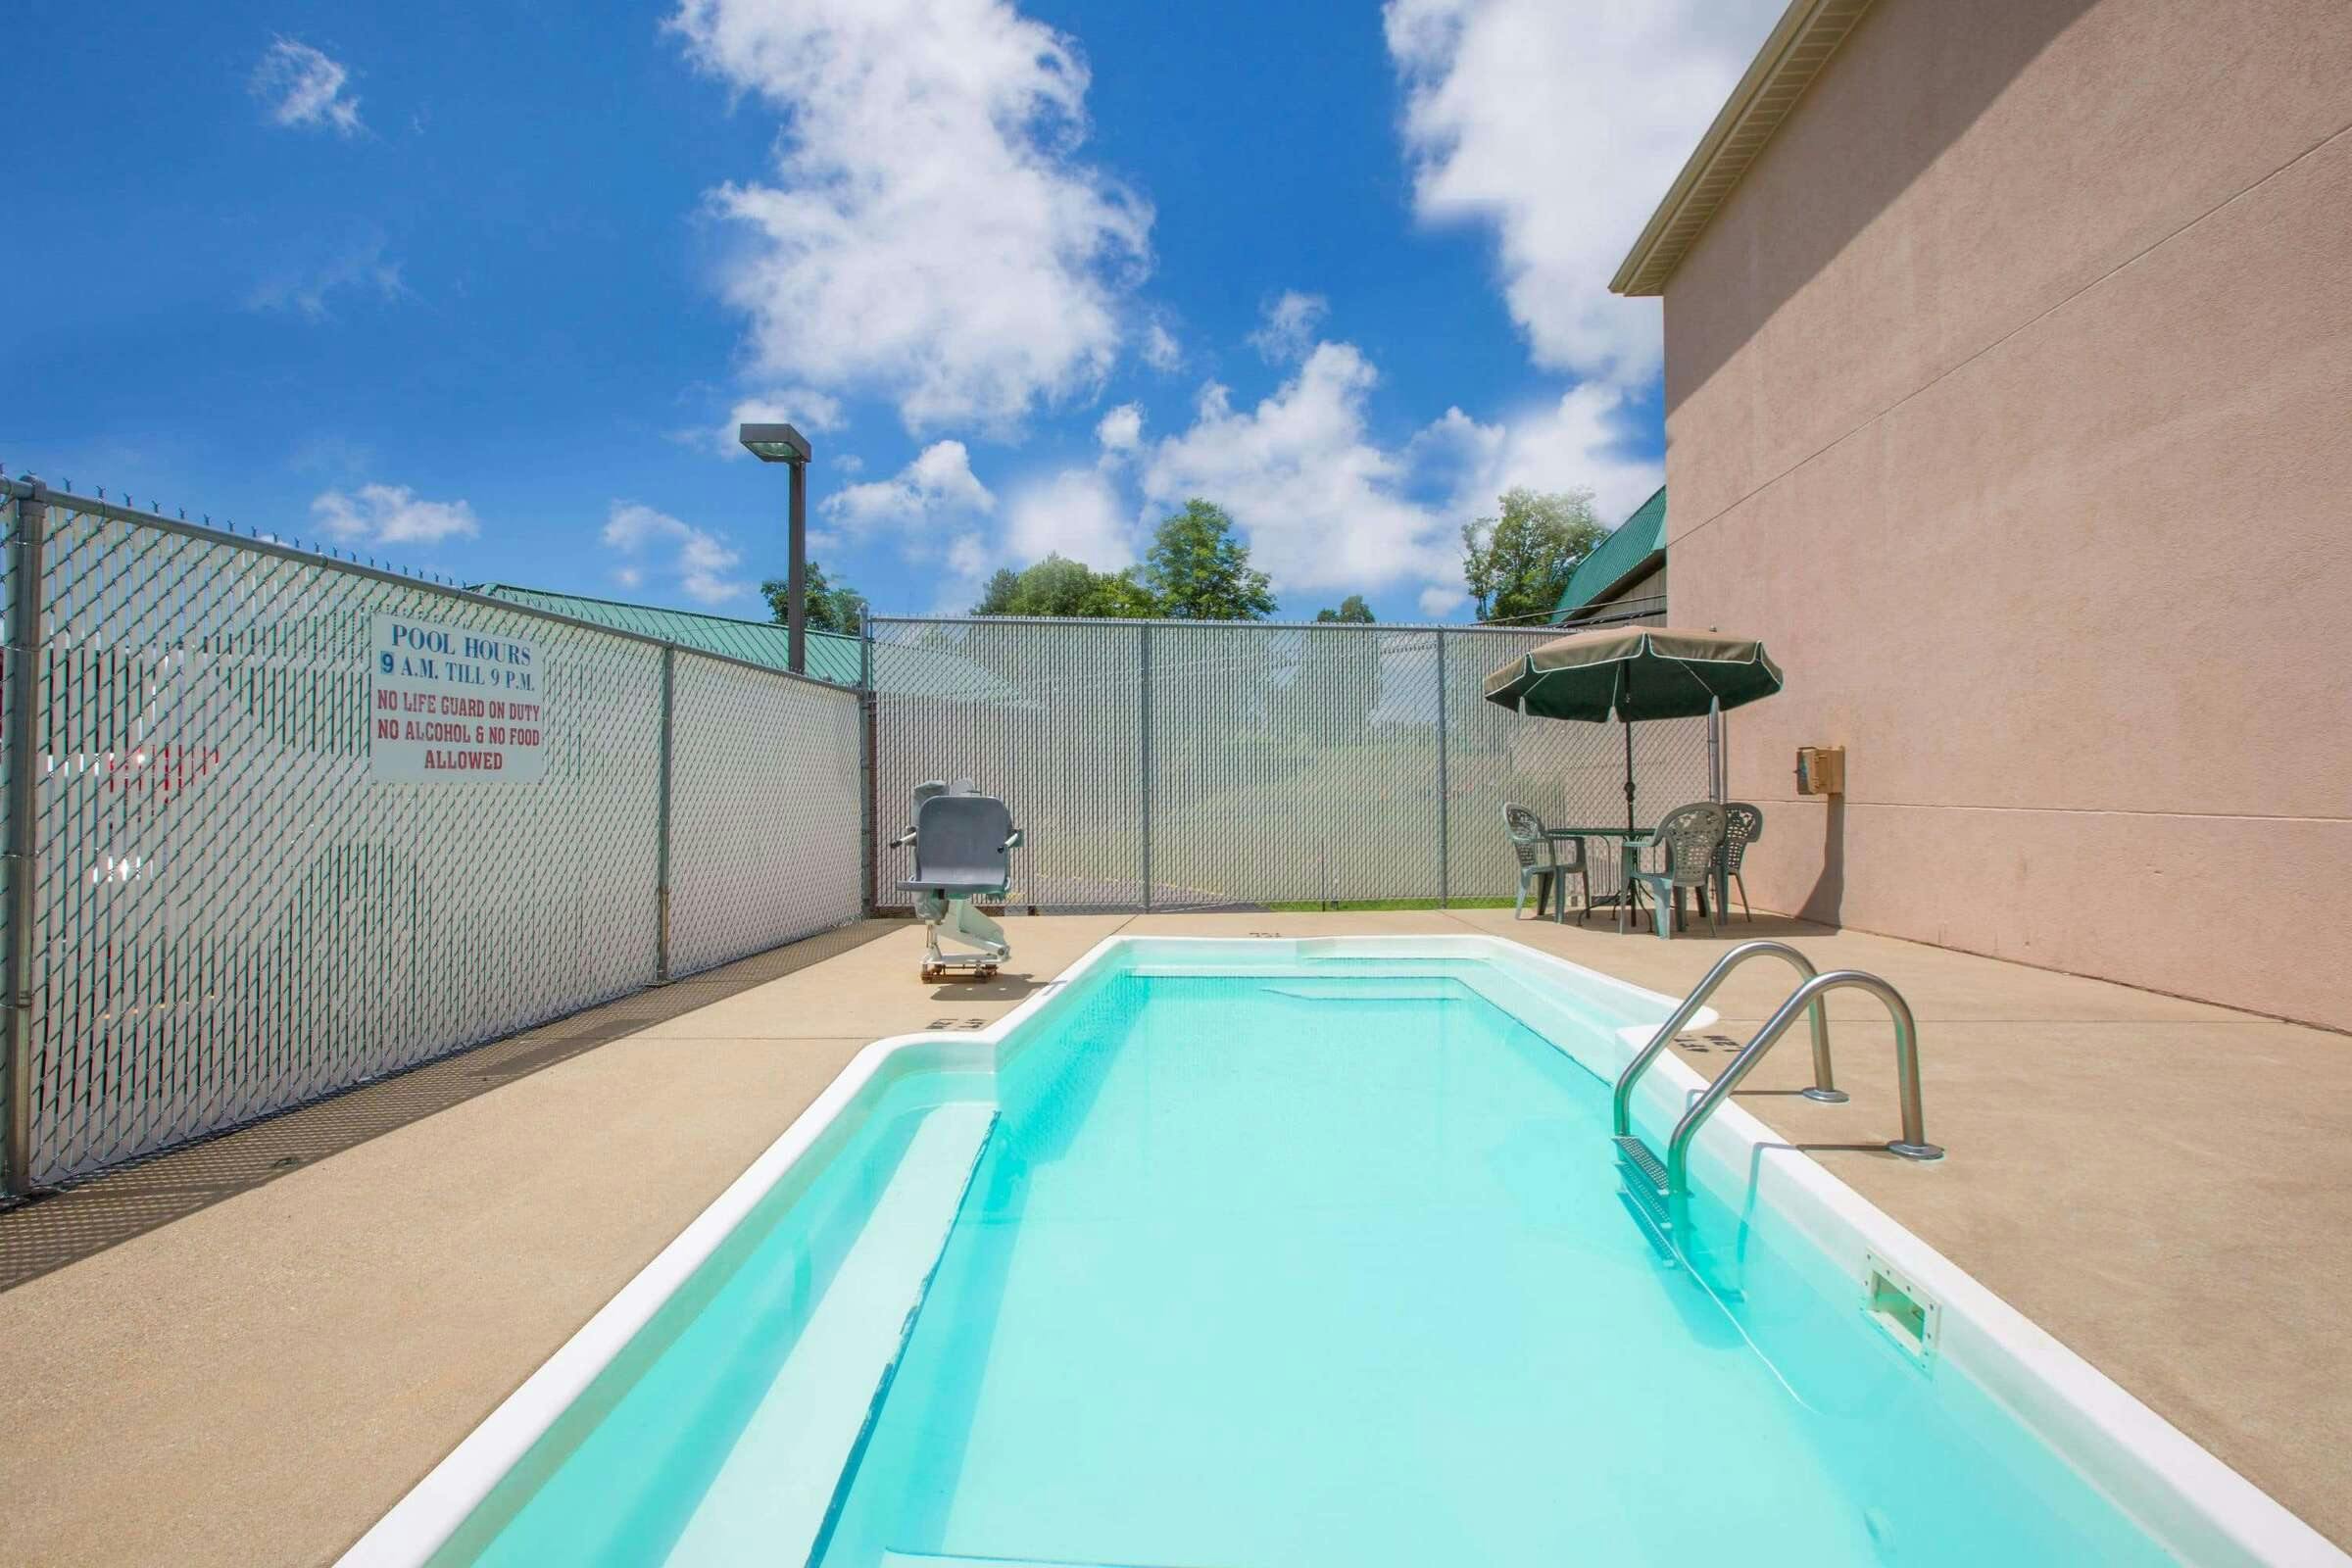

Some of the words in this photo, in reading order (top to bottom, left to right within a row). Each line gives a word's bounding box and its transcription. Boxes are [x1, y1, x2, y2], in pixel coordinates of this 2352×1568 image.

[391, 624, 455, 655] POOL
[464, 637, 531, 666] HOURS
[382, 654, 394, 673] 9
[401, 657, 438, 679] A.M.
[446, 662, 485, 686] TILL
[491, 668, 500, 686] 9
[506, 670, 535, 692] P.M.
[377, 689, 397, 711] NO
[403, 692, 436, 714] LIFE
[441, 696, 484, 718] GUARD
[489, 701, 505, 719] ON
[510, 703, 540, 722] DUTY
[378, 719, 398, 740] NO
[405, 721, 470, 744] ALCOHOL
[475, 726, 484, 744] &
[489, 727, 505, 745] NO
[510, 728, 539, 746] FOOD
[424, 750, 503, 770] ALLOWED
